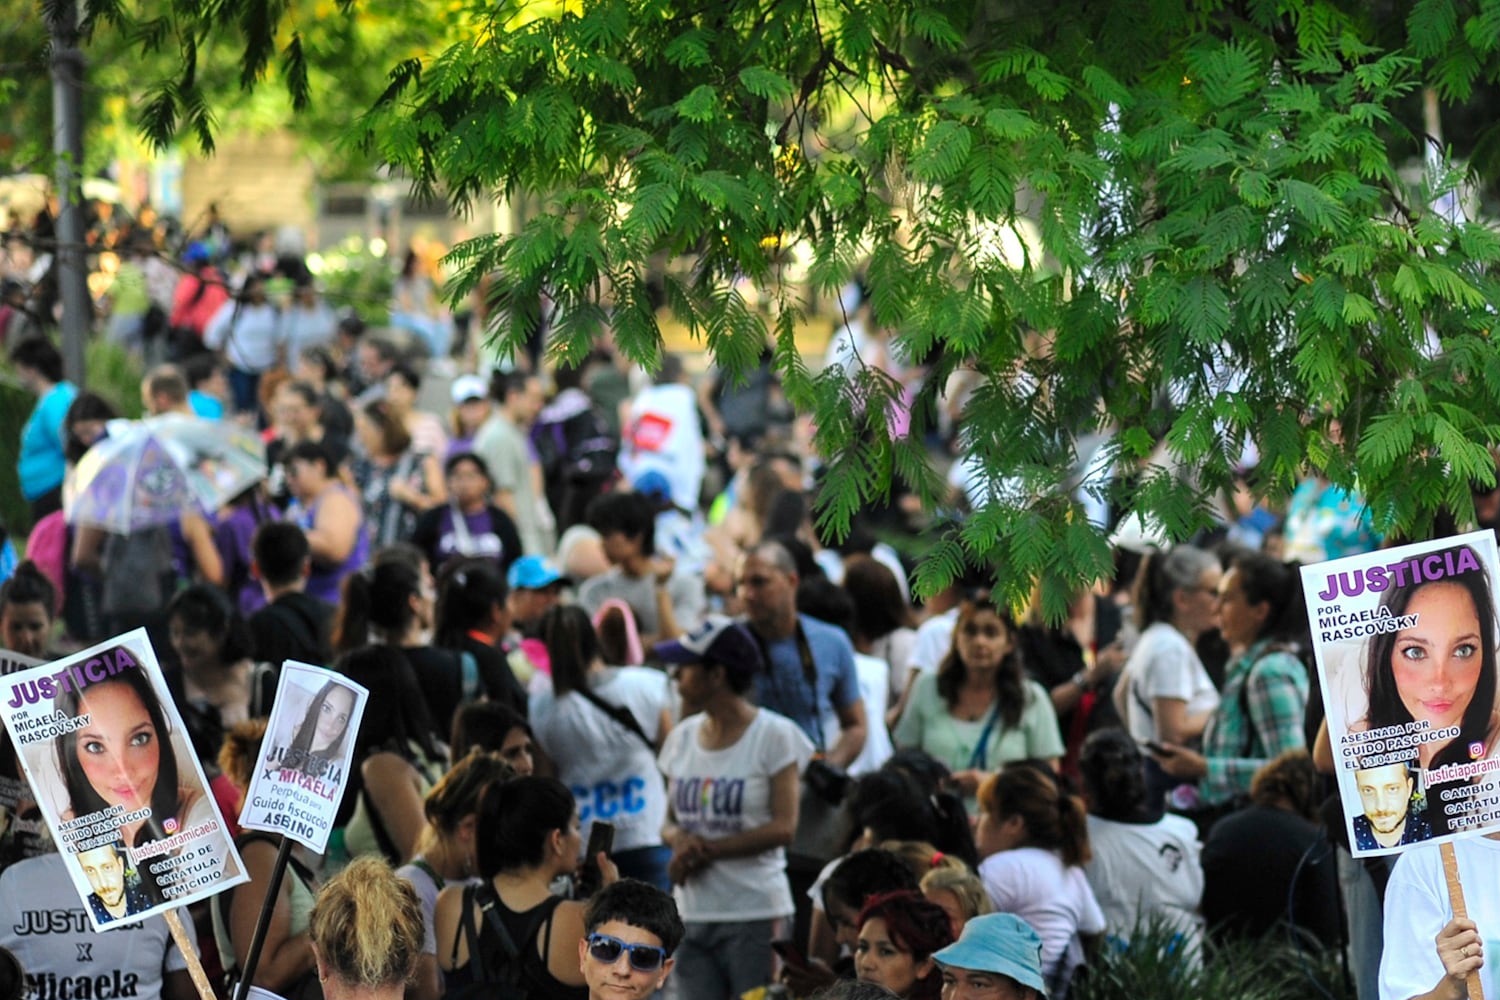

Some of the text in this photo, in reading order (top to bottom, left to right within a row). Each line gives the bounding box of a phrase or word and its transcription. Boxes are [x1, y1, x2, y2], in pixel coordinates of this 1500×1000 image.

[1319, 548, 1480, 601] JUSTICIA
[1318, 605, 1341, 616] POR
[1319, 606, 1391, 629] MICAELA
[1322, 615, 1418, 643] RASCOVSKY
[8, 650, 136, 708] JUSTICIA
[11, 710, 28, 721] POR
[14, 710, 66, 733] MICAELA
[20, 715, 91, 744] RASCOVSKY
[1341, 721, 1430, 744] ASESINADA POR
[1343, 727, 1460, 757] GUIDO PASCUCCIO
[1345, 760, 1359, 769] EL
[252, 796, 285, 812] Guido
[1441, 782, 1494, 800] CAMBIO
[58, 805, 125, 832] ASESINADA POR
[62, 808, 151, 843] GUIDO PASCUCCIO
[132, 820, 219, 863] justiciaparamicaela
[150, 844, 214, 874] CAMBIO DE
[157, 857, 221, 886] CARATULA:
[162, 870, 222, 899] FEMICIDIO
[76, 943, 93, 962] X
